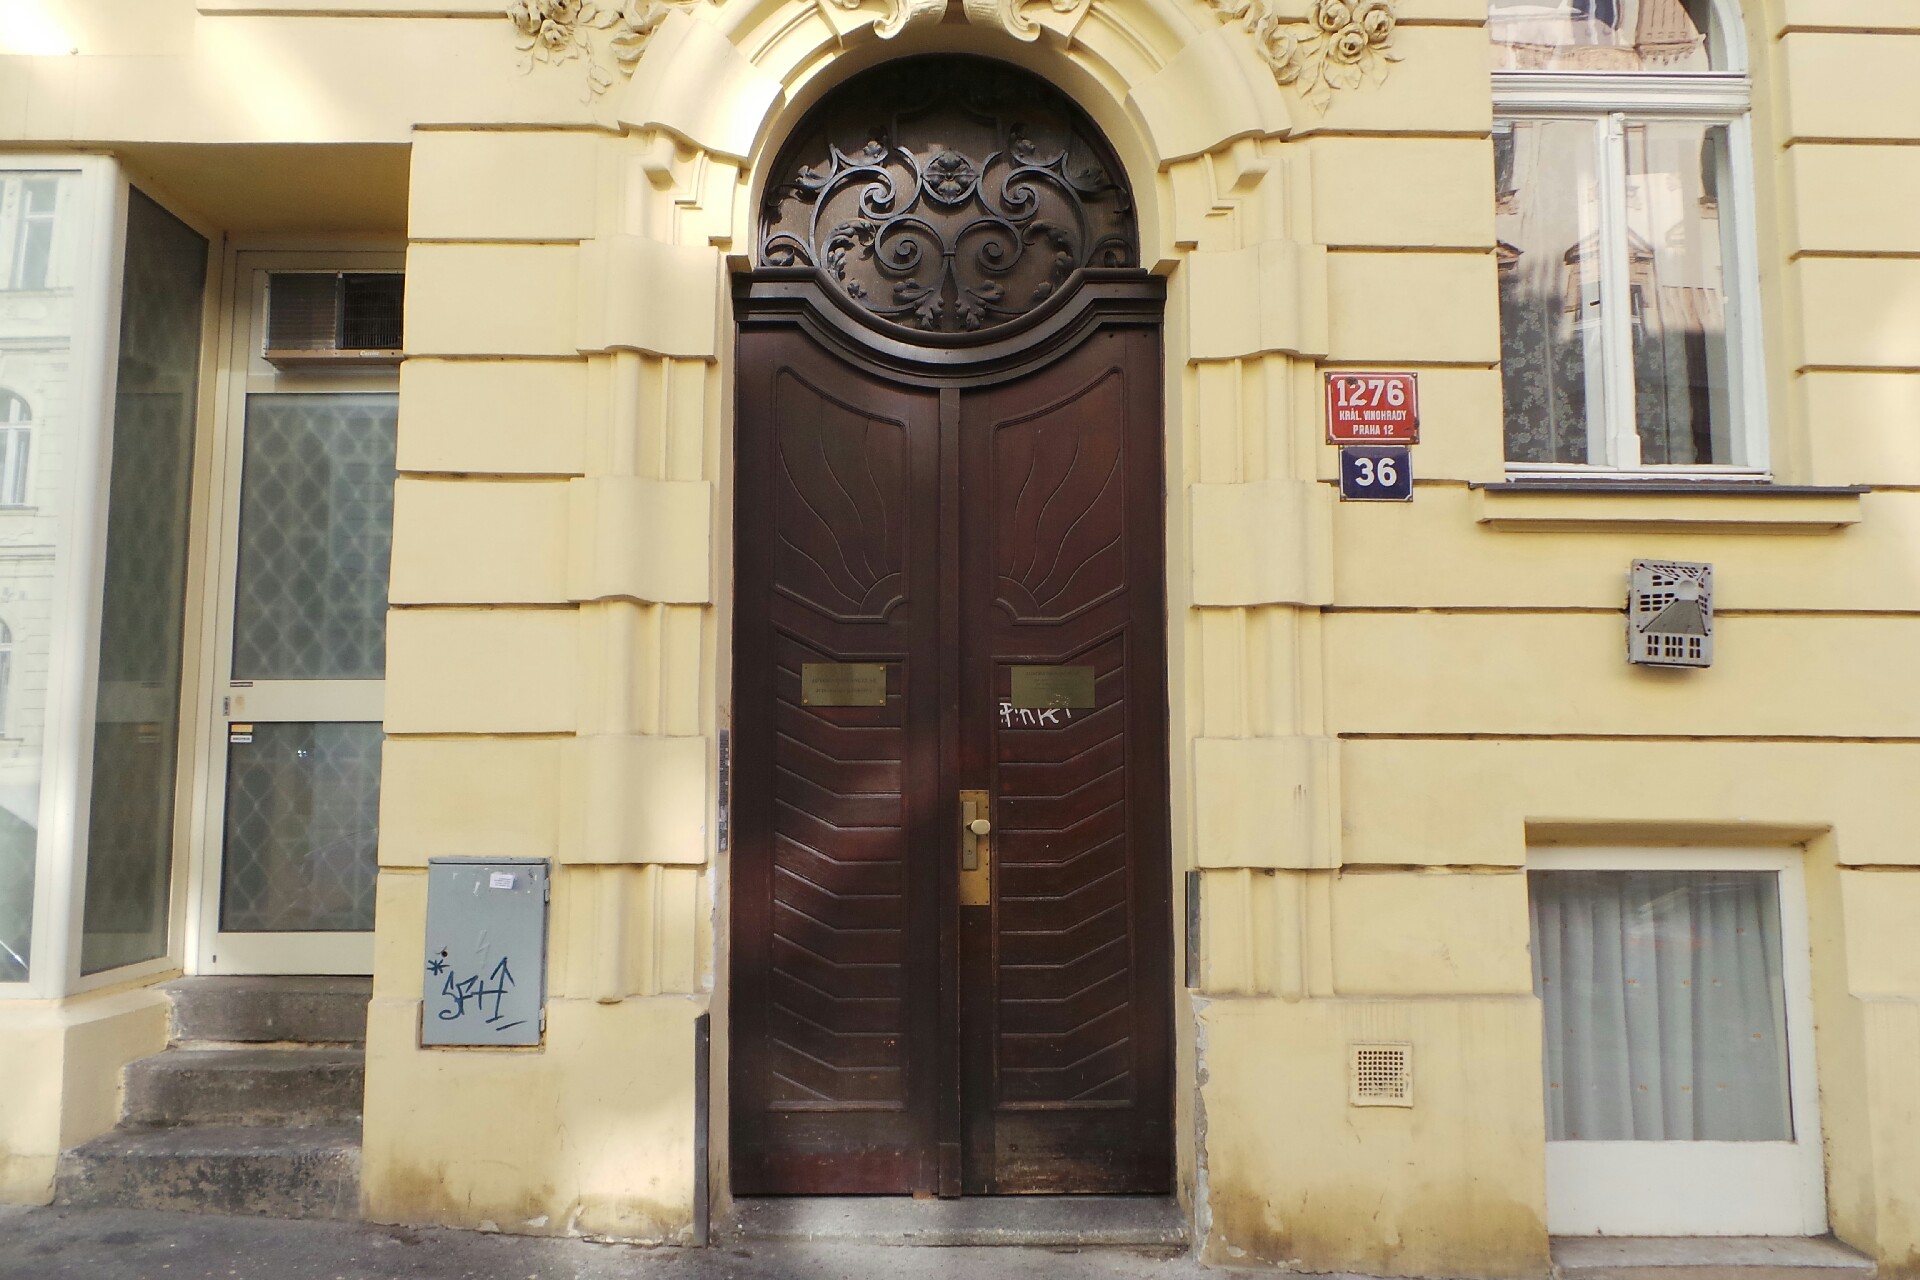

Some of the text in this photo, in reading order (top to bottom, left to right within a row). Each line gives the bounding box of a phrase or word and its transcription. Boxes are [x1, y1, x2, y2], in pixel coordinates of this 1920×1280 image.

[1337, 379, 1405, 406] 1276
[1339, 408, 1407, 421] KRÁL. VINOHRADY
[1353, 425, 1394, 435] PRAHA 12
[1354, 457, 1397, 487] 36
